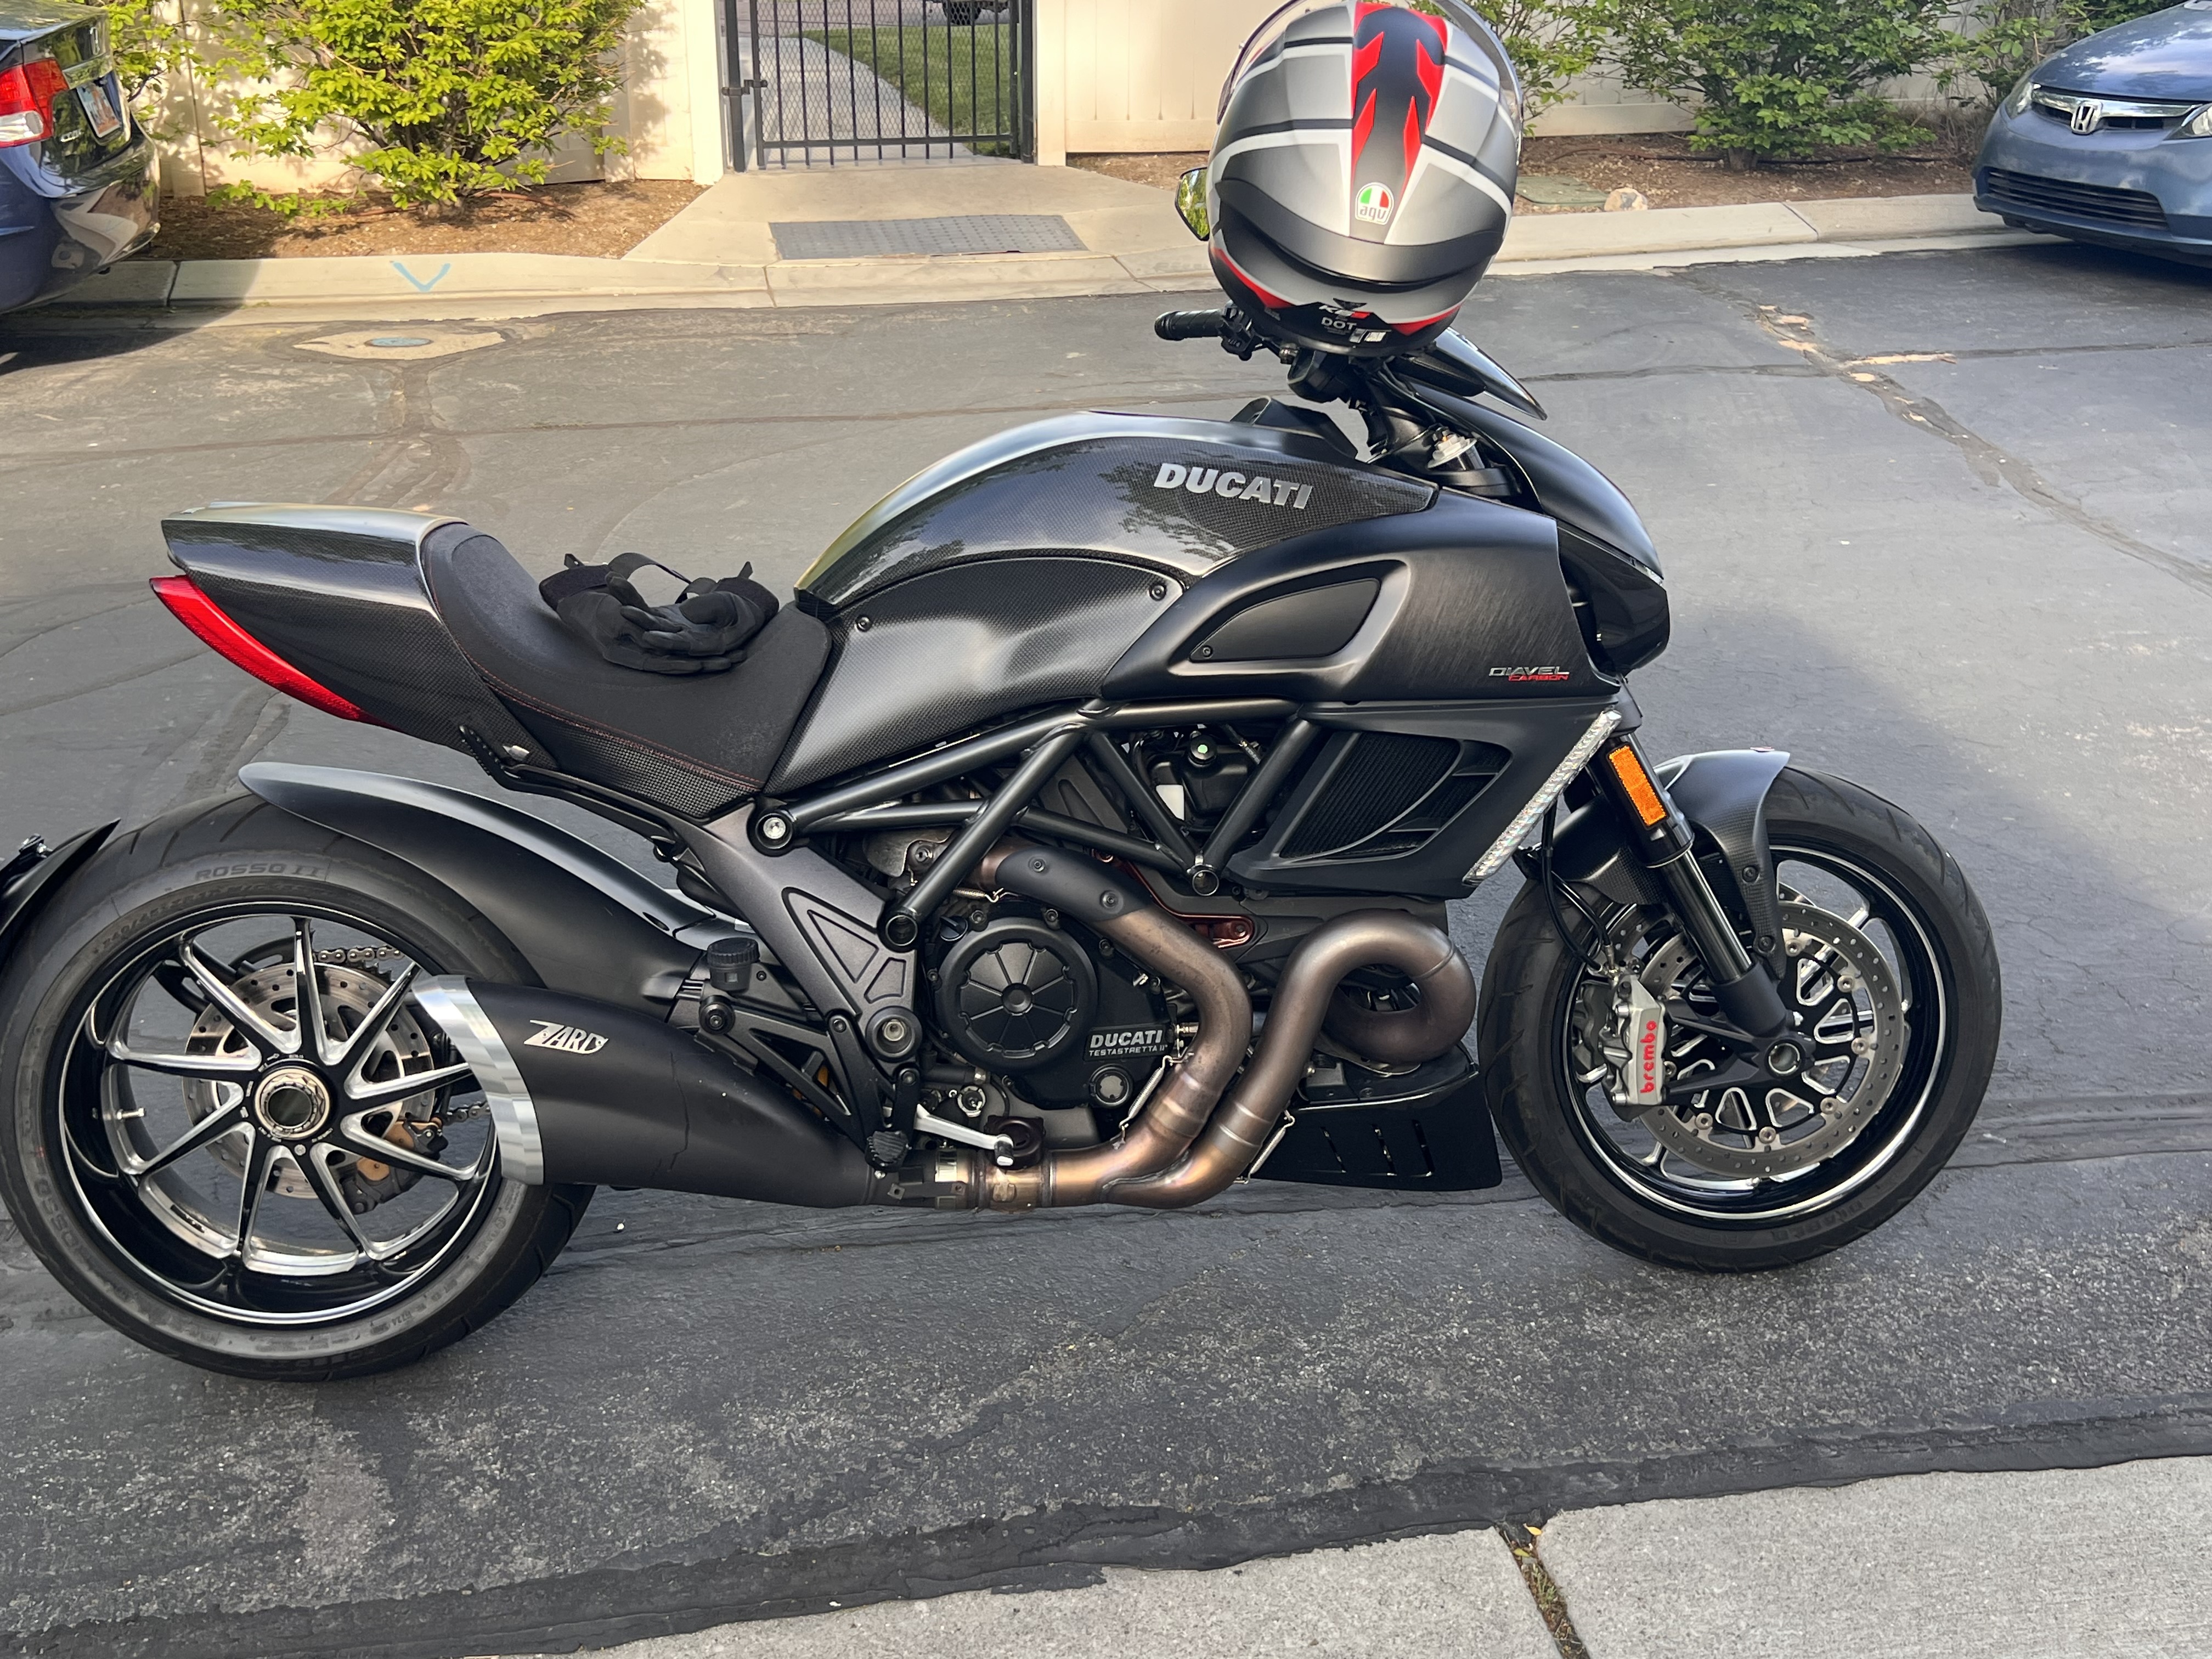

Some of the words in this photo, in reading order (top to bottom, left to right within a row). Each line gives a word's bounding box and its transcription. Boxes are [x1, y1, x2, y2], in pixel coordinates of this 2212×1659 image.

[1359, 205, 1387, 221] agv
[1321, 317, 1357, 330] DOT
[1153, 463, 1313, 509] DUCATI
[1489, 666, 1570, 676] DIAVEL
[523, 1020, 609, 1054] ZARD
[1090, 1030, 1163, 1048] DUCATI
[1089, 1045, 1158, 1057] TESTASTRETTA
[1640, 1020, 1657, 1094] brembo
